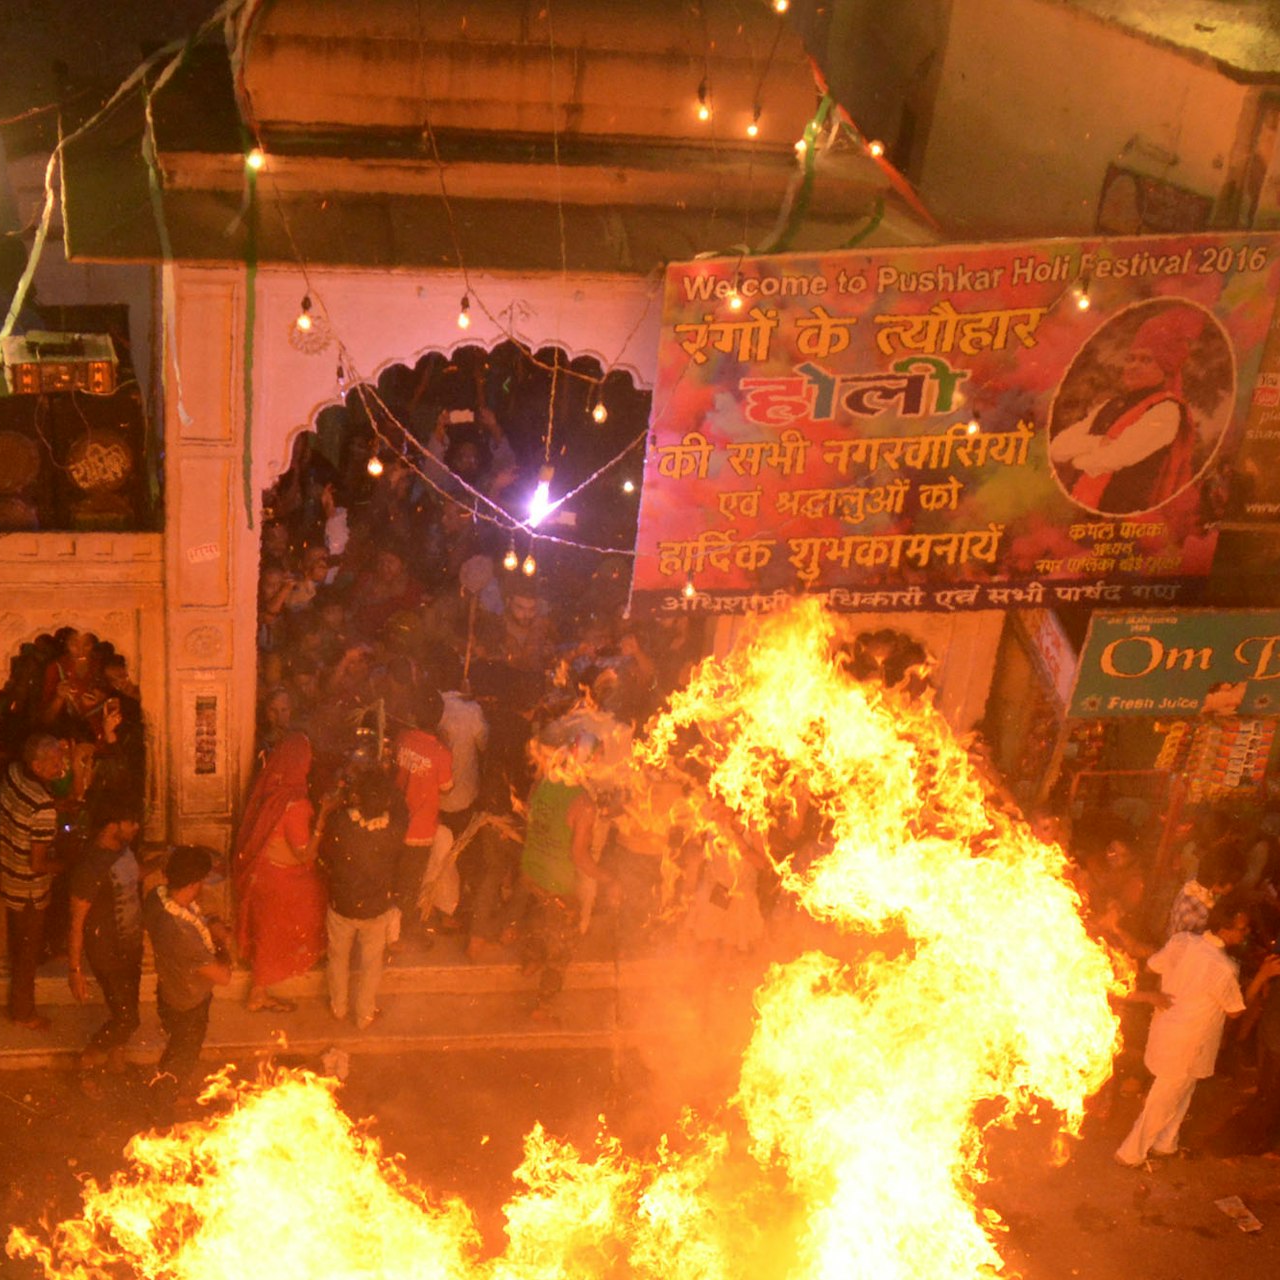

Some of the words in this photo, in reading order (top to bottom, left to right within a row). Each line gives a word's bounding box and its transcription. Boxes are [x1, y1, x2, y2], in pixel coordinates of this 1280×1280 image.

[683, 271, 828, 301] Welcome
[837, 270, 868, 294] to
[877, 263, 1006, 295] Pushkar
[1011, 254, 1070, 286] Holi
[1078, 248, 1191, 281] Festival
[1197, 246, 1268, 274] 2016
[674, 307, 780, 366] रंगों
[795, 306, 857, 358] के
[873, 300, 1050, 356] त्यौहार
[739, 355, 972, 426] होली
[657, 432, 714, 480] की
[726, 427, 811, 477] सभी
[718, 486, 763, 520] एवं
[919, 475, 964, 513] को
[657, 529, 776, 576] हार्दिक
[788, 523, 1006, 580] शुभकामनायें
[934, 584, 981, 610] एवं
[986, 582, 1046, 605] सभी
[1053, 580, 1124, 602] पार्षद
[1099, 635, 1213, 679] Om
[1106, 696, 1156, 711] Fresh
[1158, 697, 1199, 710] Juice
